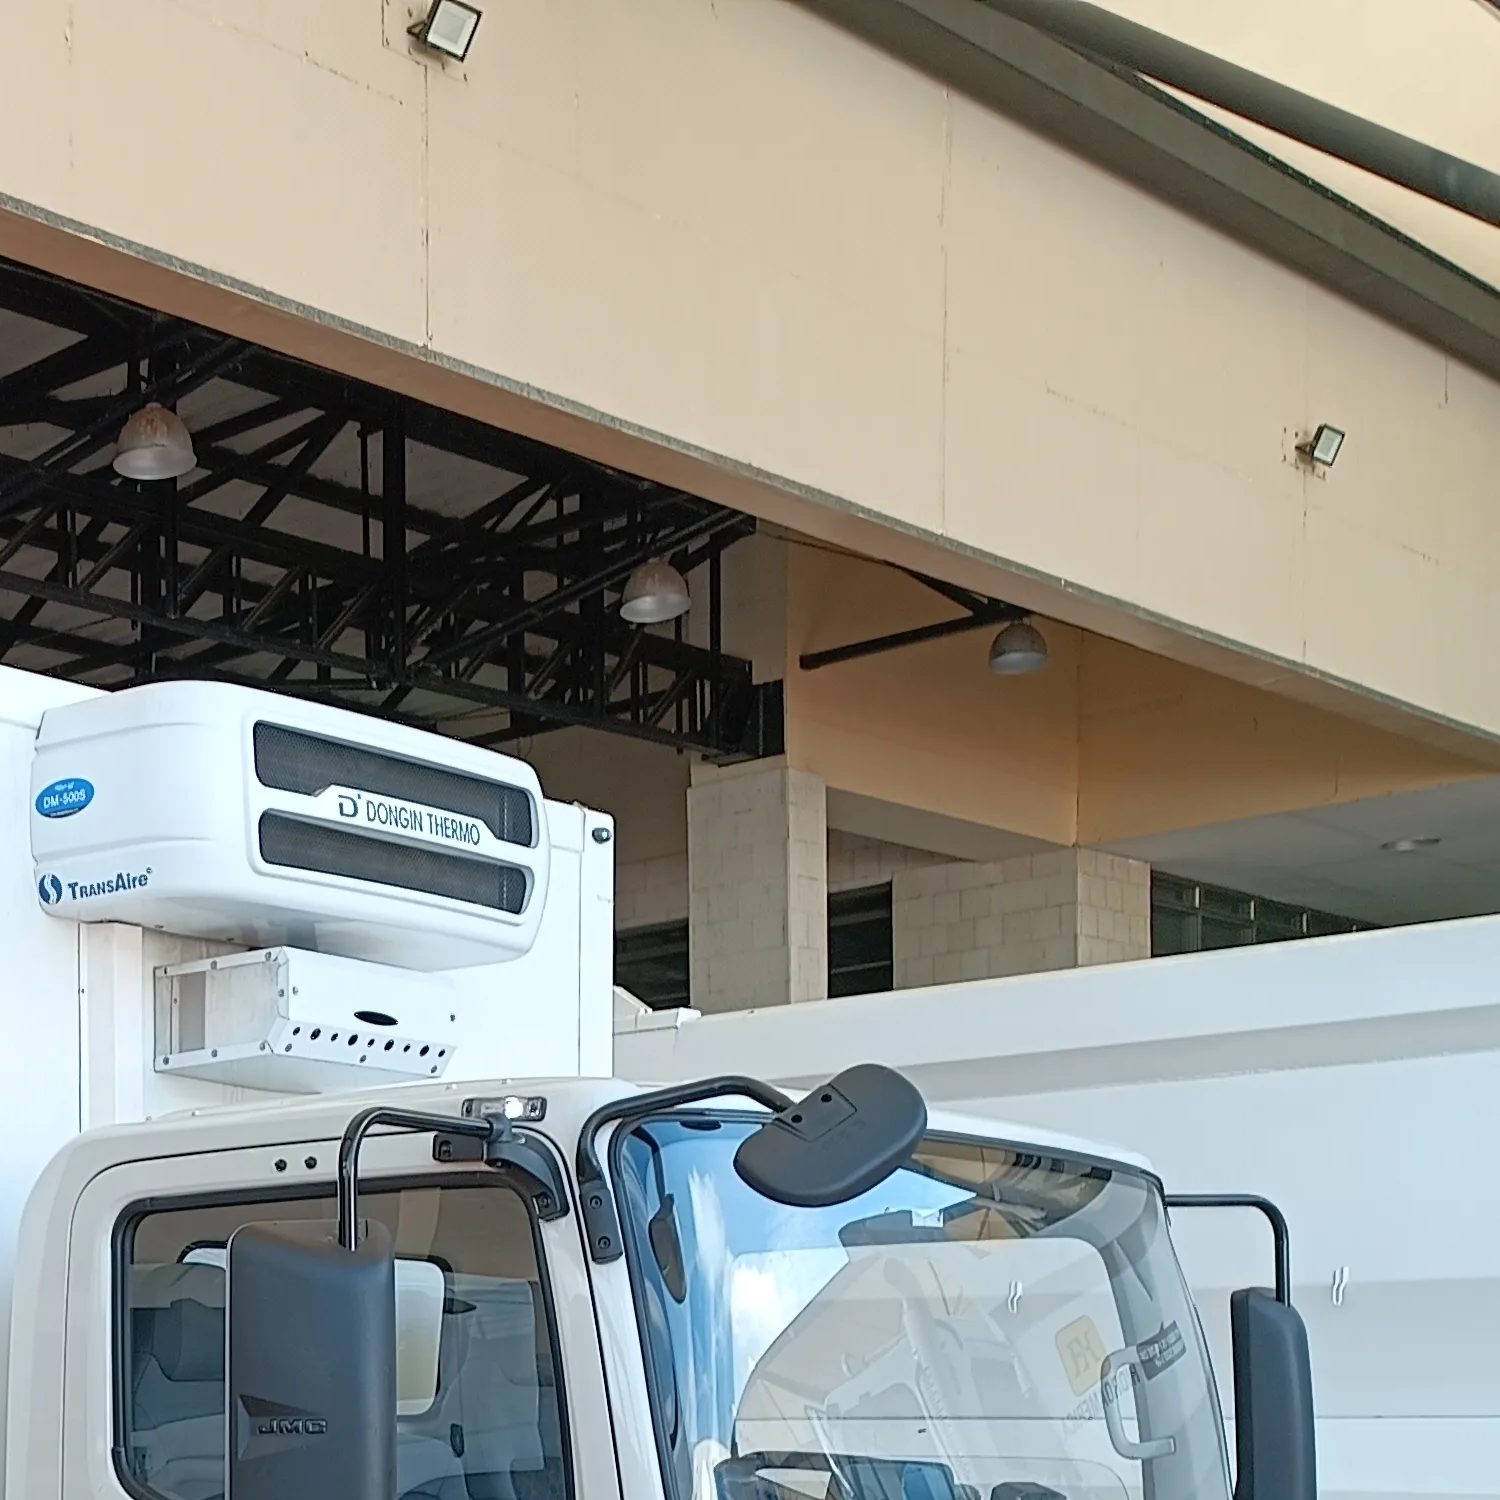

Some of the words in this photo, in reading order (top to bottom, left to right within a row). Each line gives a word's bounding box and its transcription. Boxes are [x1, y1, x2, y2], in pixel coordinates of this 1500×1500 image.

[365, 799, 424, 833] DONGIN
[426, 812, 481, 846] THERMO
[256, 1416, 328, 1436] JMC
